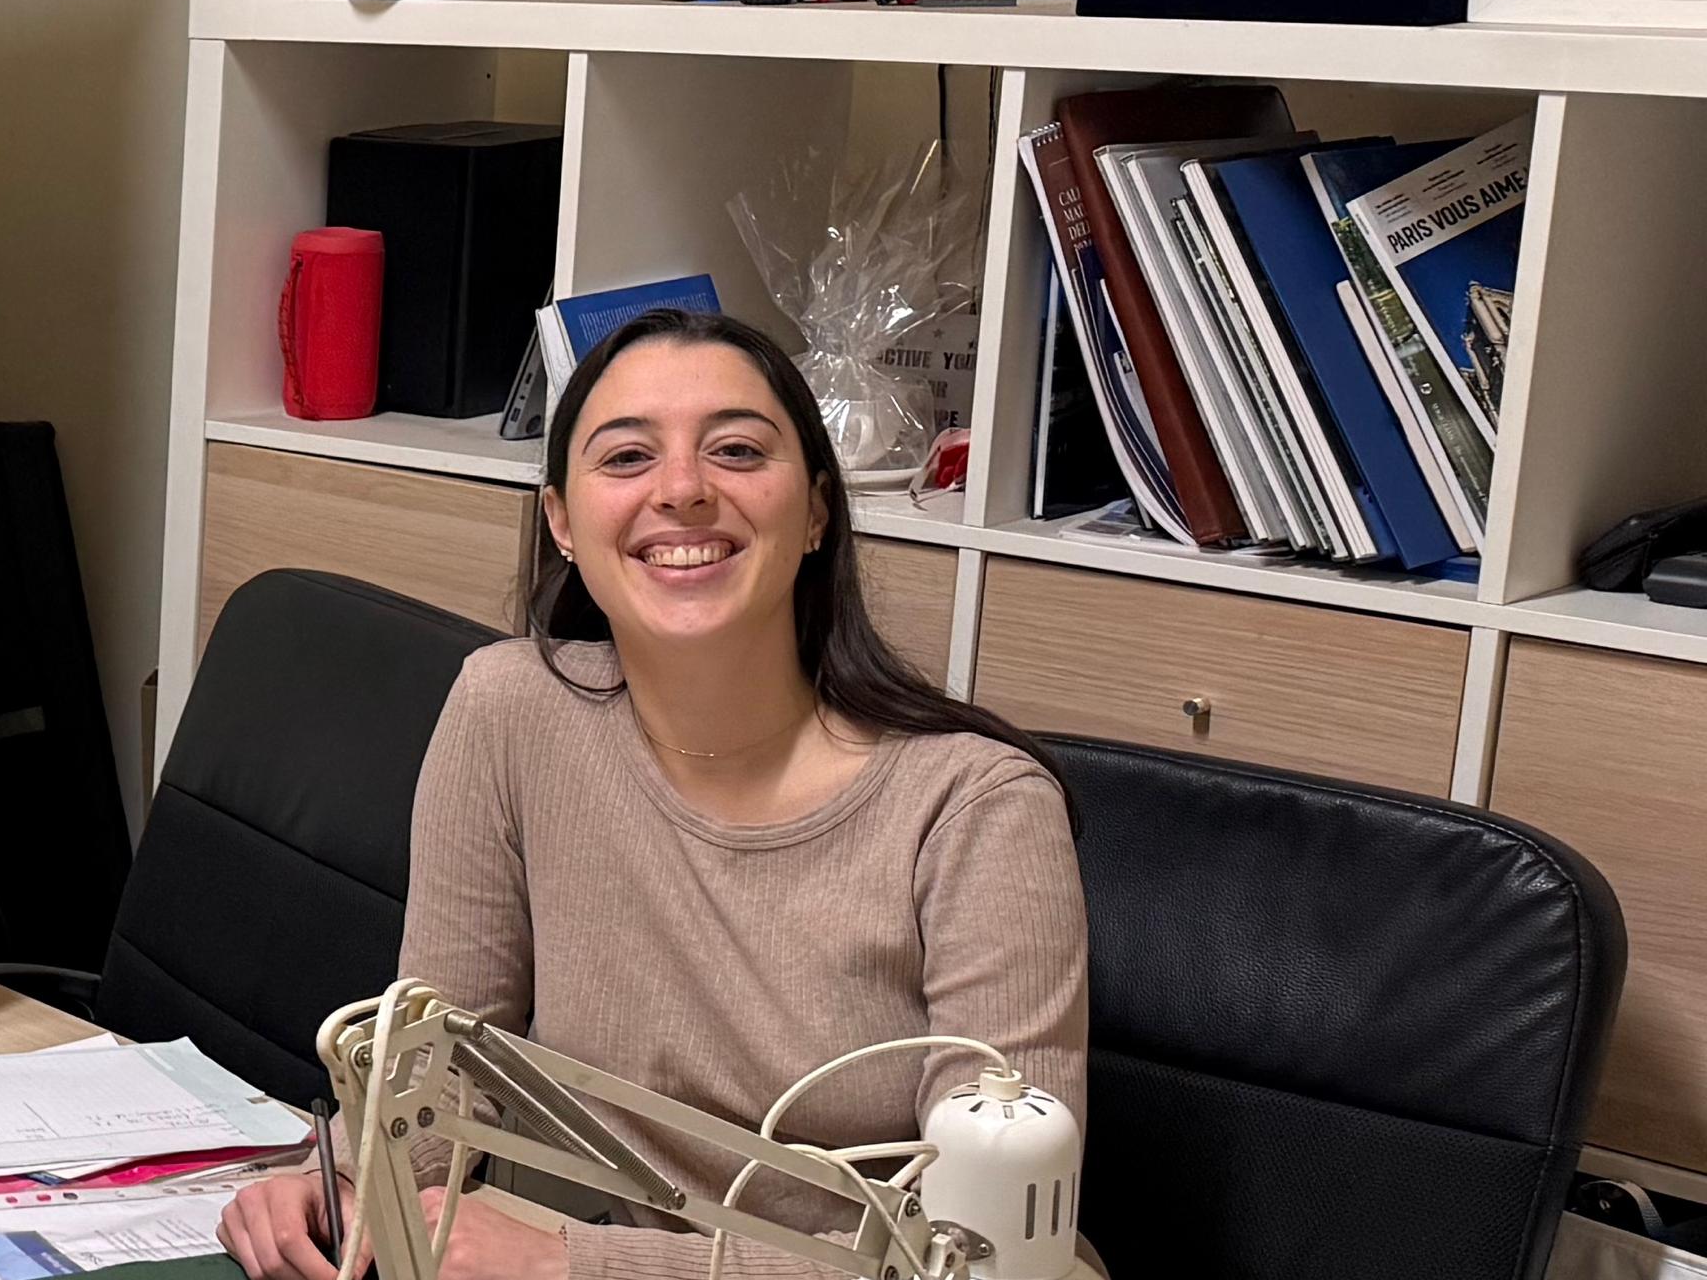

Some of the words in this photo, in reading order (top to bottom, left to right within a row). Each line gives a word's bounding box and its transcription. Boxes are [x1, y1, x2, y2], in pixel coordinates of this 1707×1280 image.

[1387, 219, 1434, 254] PARIS
[1428, 194, 1482, 231] VOUS
[1479, 171, 1527, 209] AIME
